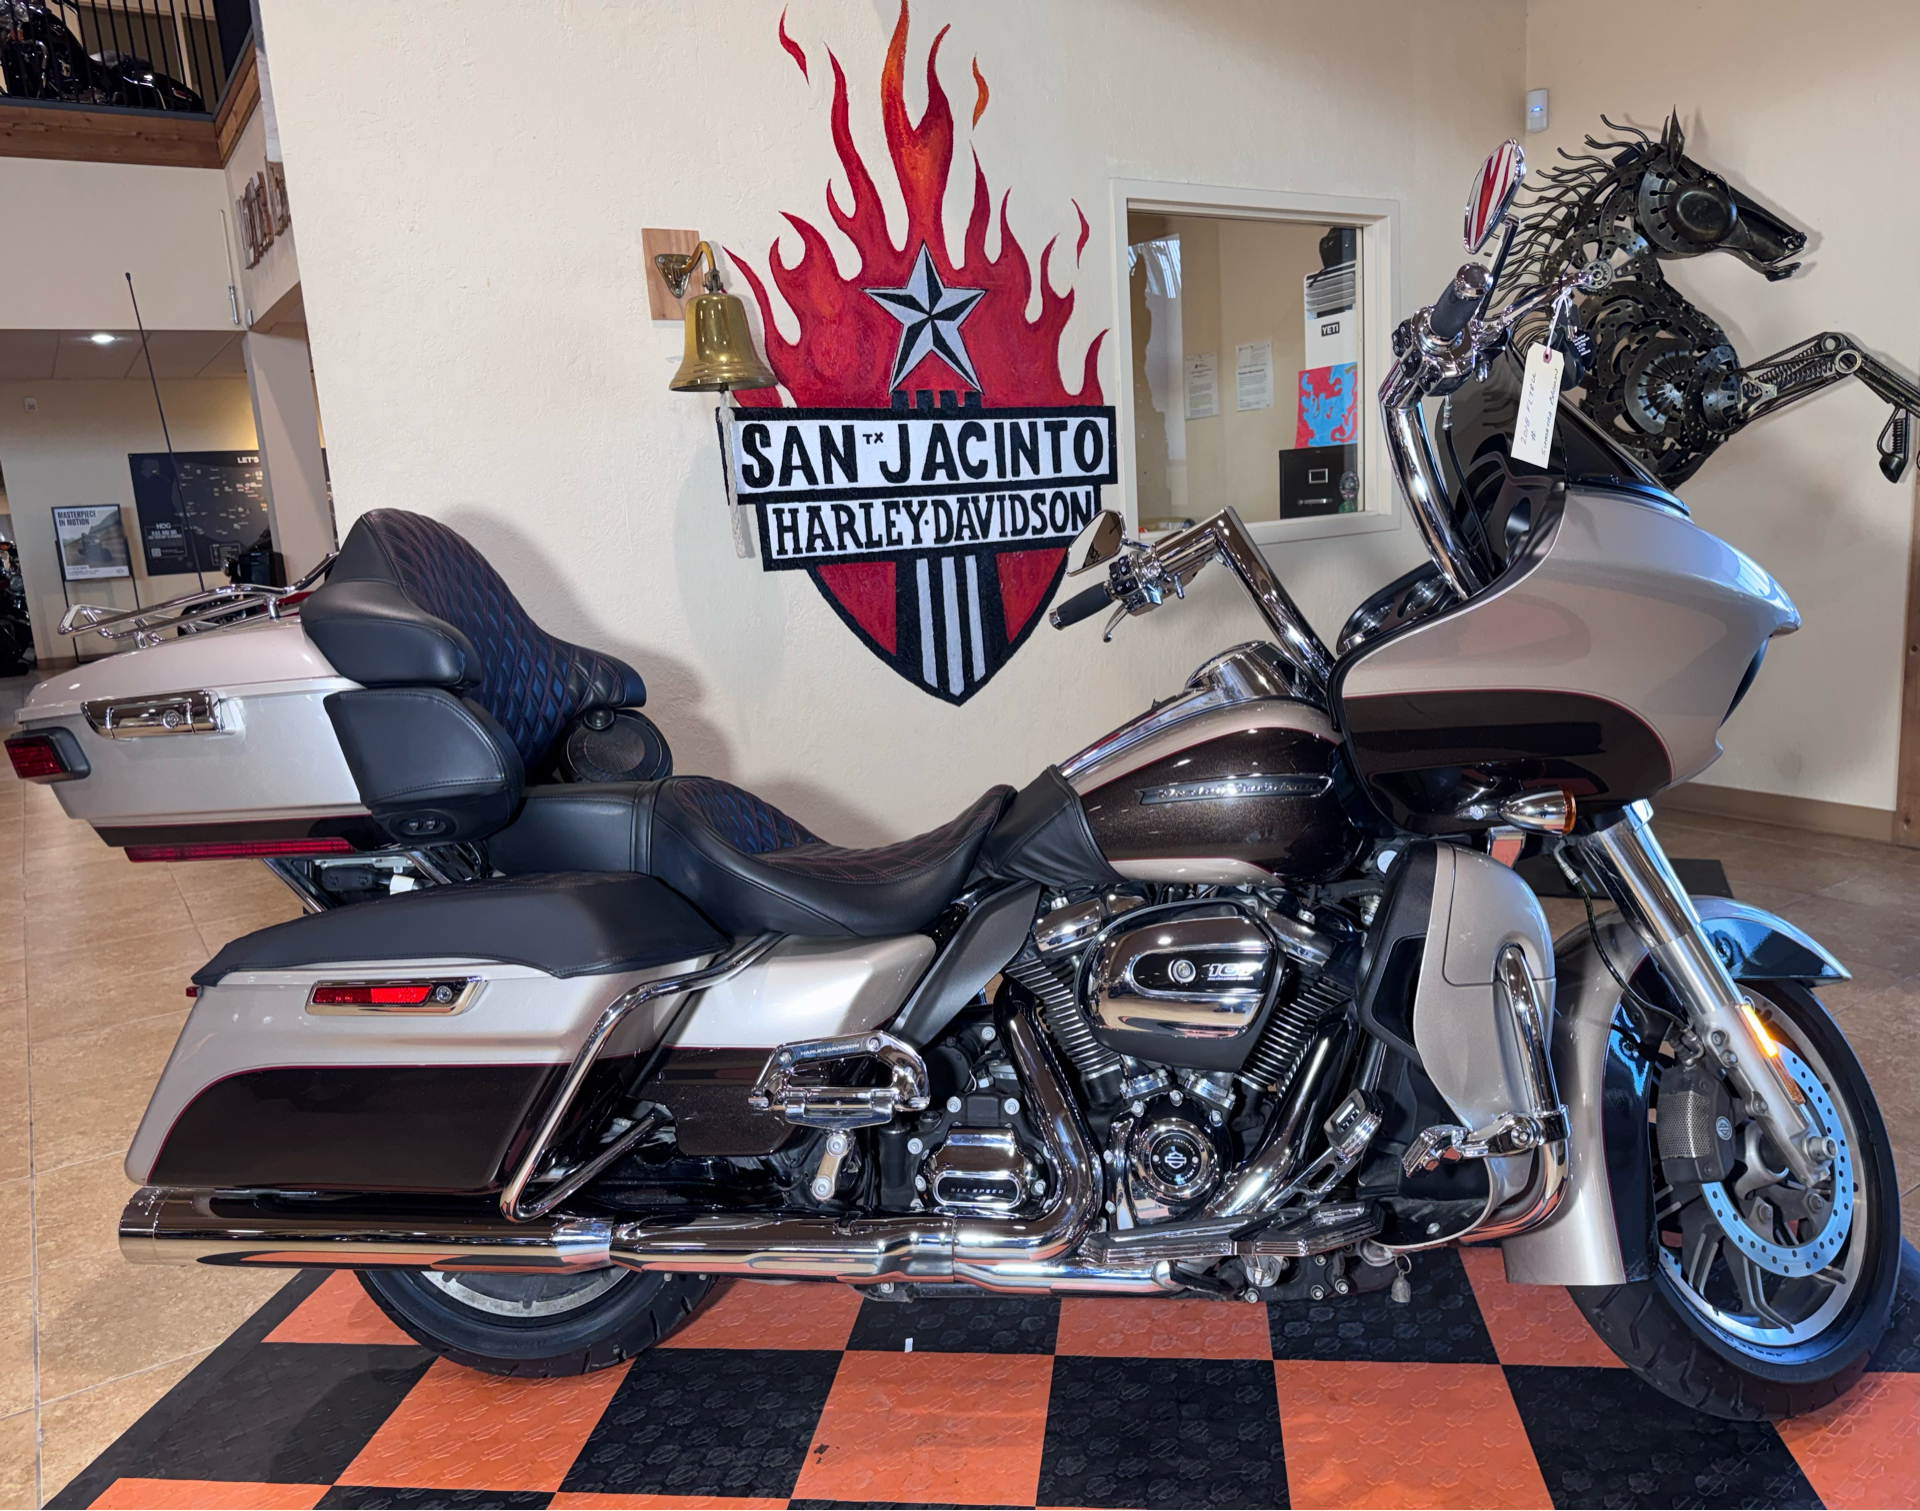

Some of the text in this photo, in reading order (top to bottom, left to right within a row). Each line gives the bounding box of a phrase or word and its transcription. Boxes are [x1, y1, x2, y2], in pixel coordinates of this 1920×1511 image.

[1322, 323, 1339, 335] YETI
[1520, 416, 1532, 446] 2018
[862, 432, 885, 445] TX
[237, 456, 259, 464] LET'S
[741, 419, 1104, 489] SAN JACINTO
[57, 510, 97, 519] MASTERPIECE
[59, 518, 90, 527] IN MOTION
